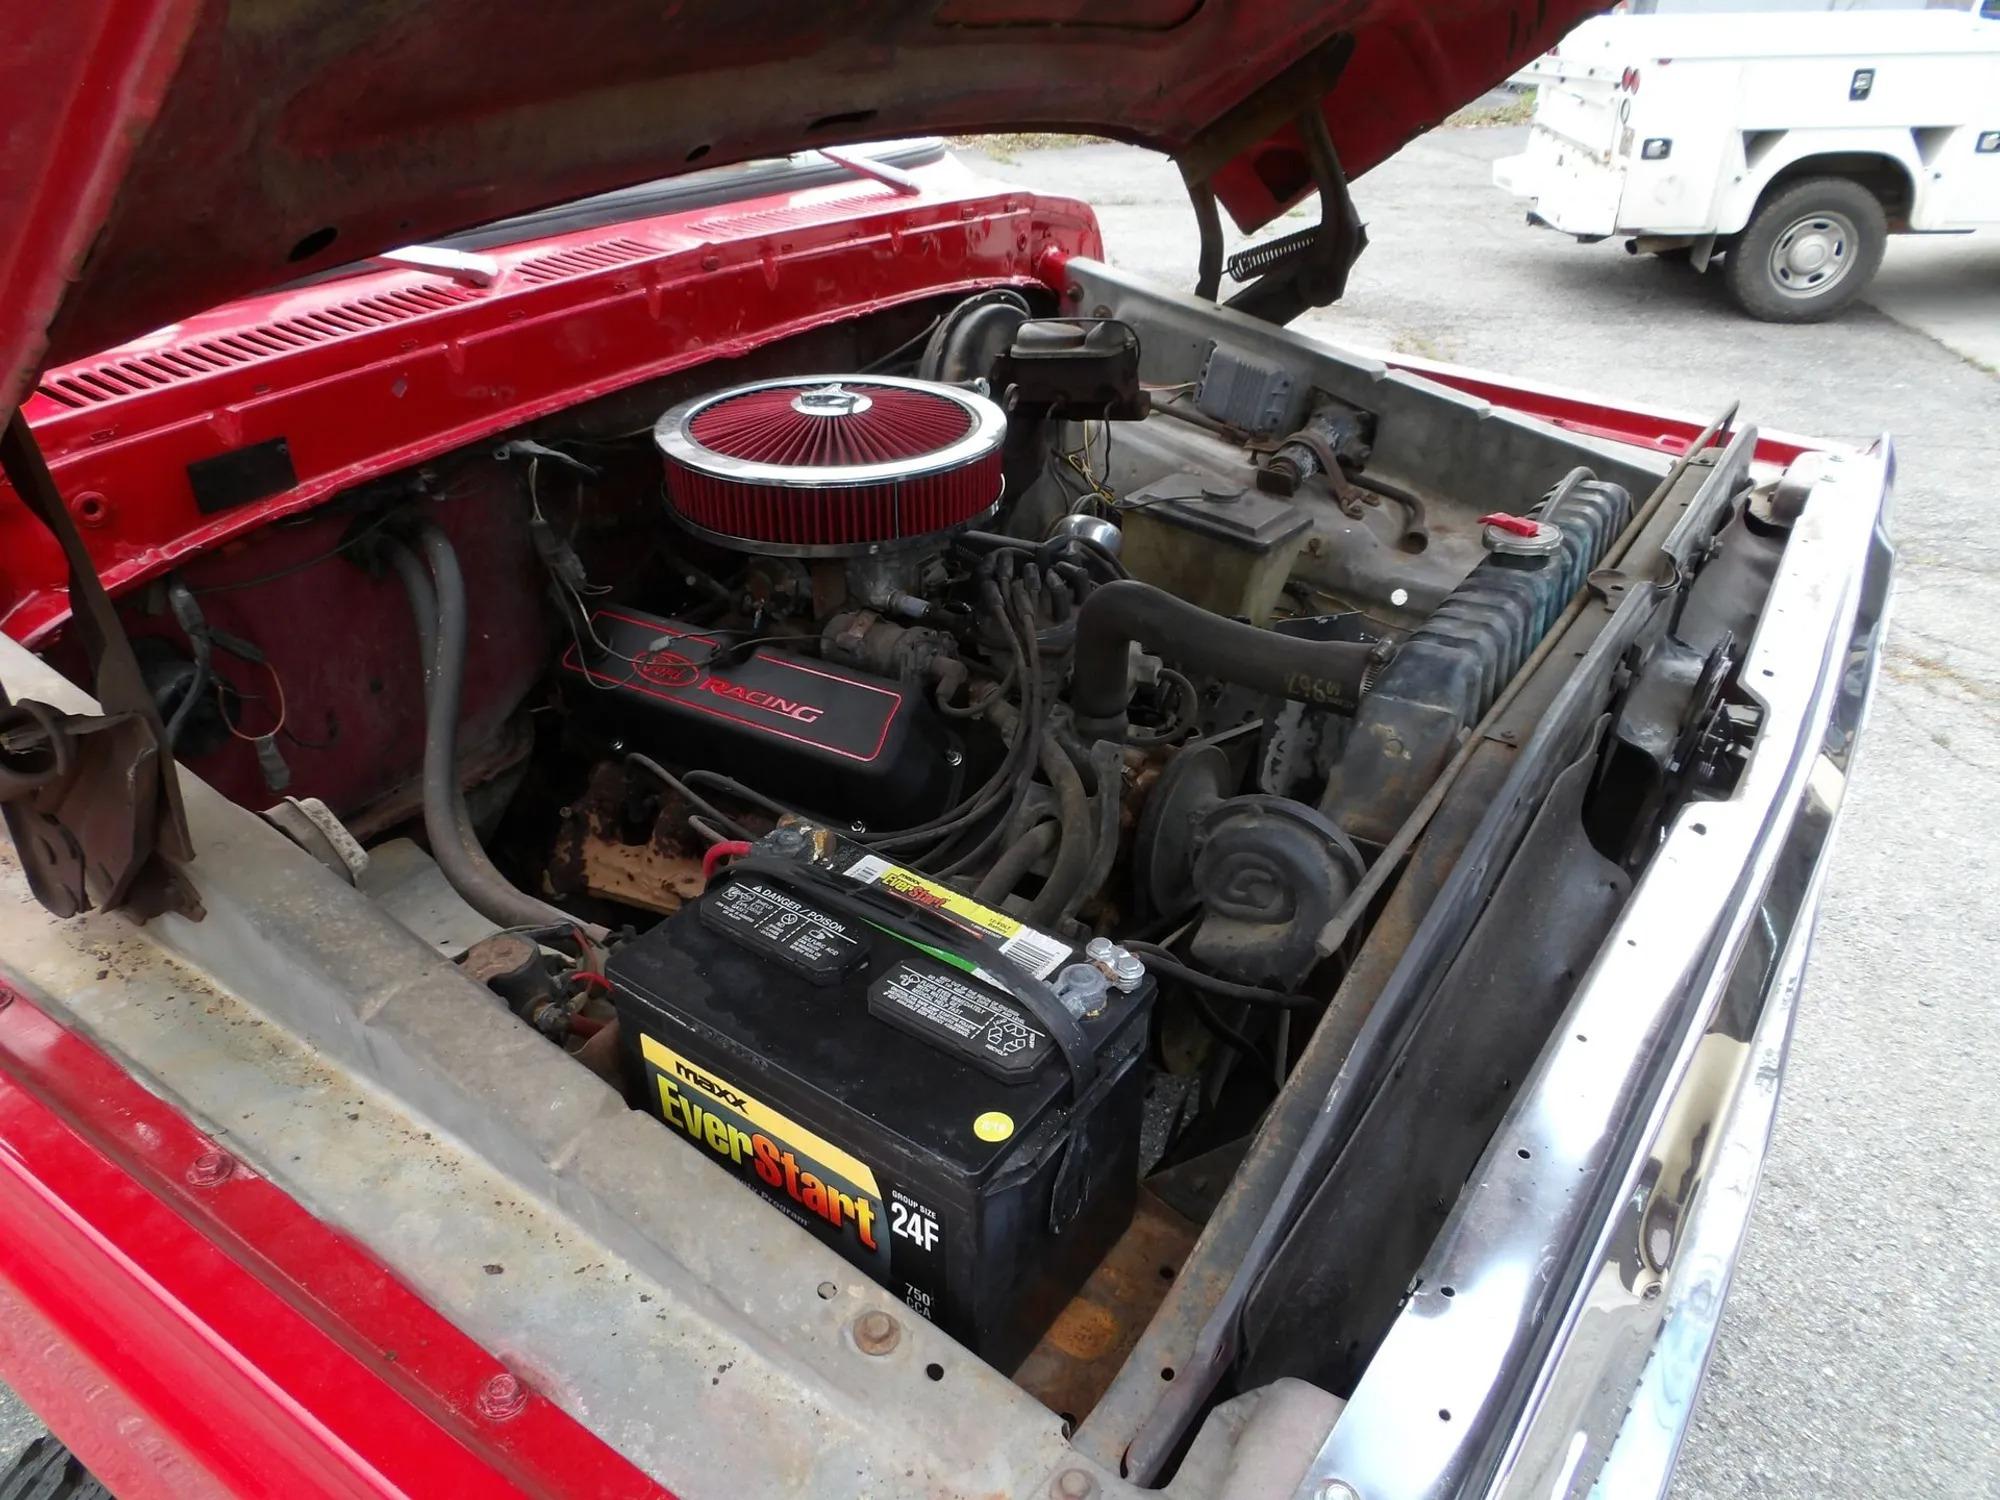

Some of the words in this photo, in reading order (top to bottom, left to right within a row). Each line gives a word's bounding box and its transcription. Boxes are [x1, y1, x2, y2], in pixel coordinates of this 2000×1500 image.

[697, 677, 824, 724] RACING
[762, 889, 800, 912] DANGER
[809, 911, 845, 933] POISON
[881, 872, 946, 909] EverStart
[675, 1061, 749, 1115] maxx
[656, 1073, 878, 1252] EverStart
[891, 1203, 939, 1252] 24F
[892, 1190, 918, 1208] GROUP
[920, 1205, 936, 1220] SIZE
[905, 1282, 931, 1306] 750
